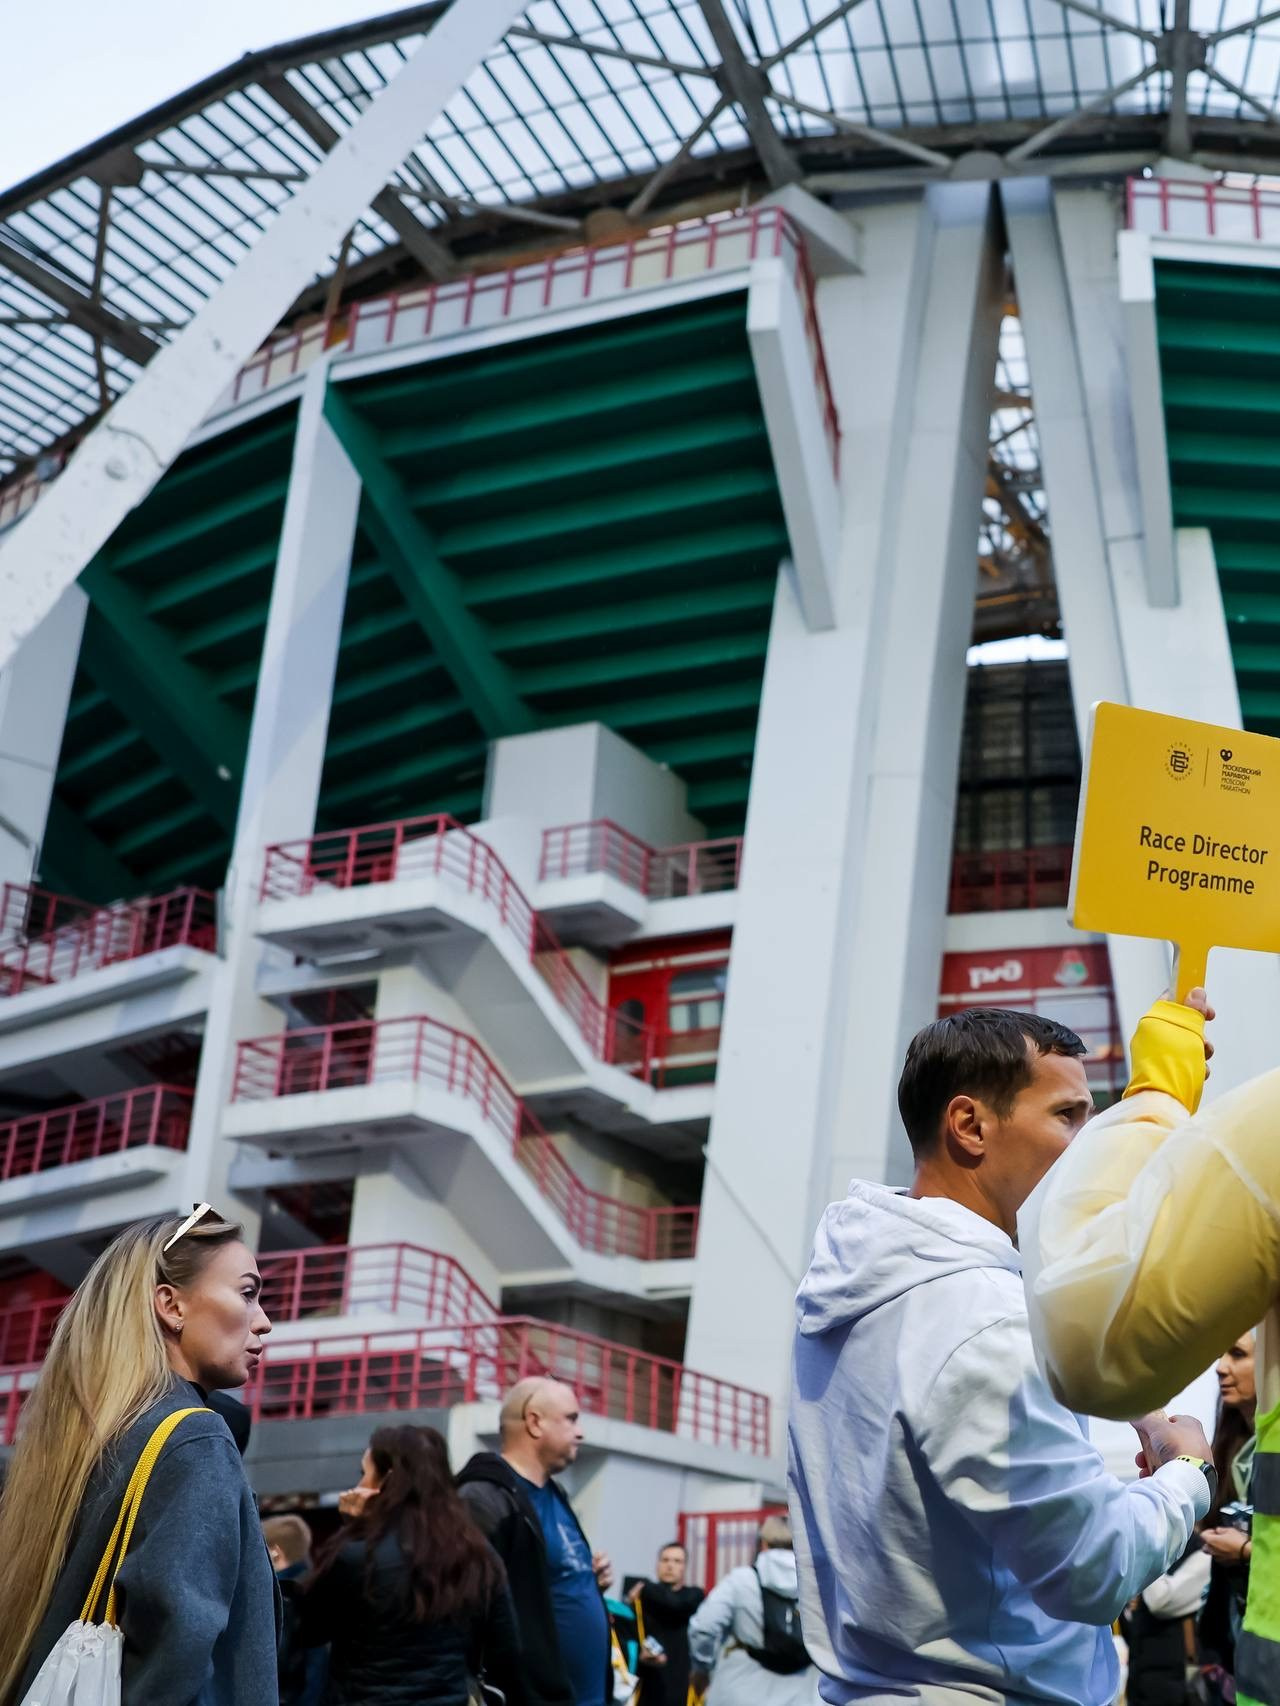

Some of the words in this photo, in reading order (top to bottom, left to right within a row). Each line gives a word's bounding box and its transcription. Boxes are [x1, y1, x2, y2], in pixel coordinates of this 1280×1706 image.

[1139, 825, 1186, 853] Race
[1192, 834, 1268, 865] Director
[1147, 860, 1255, 895] Programme
